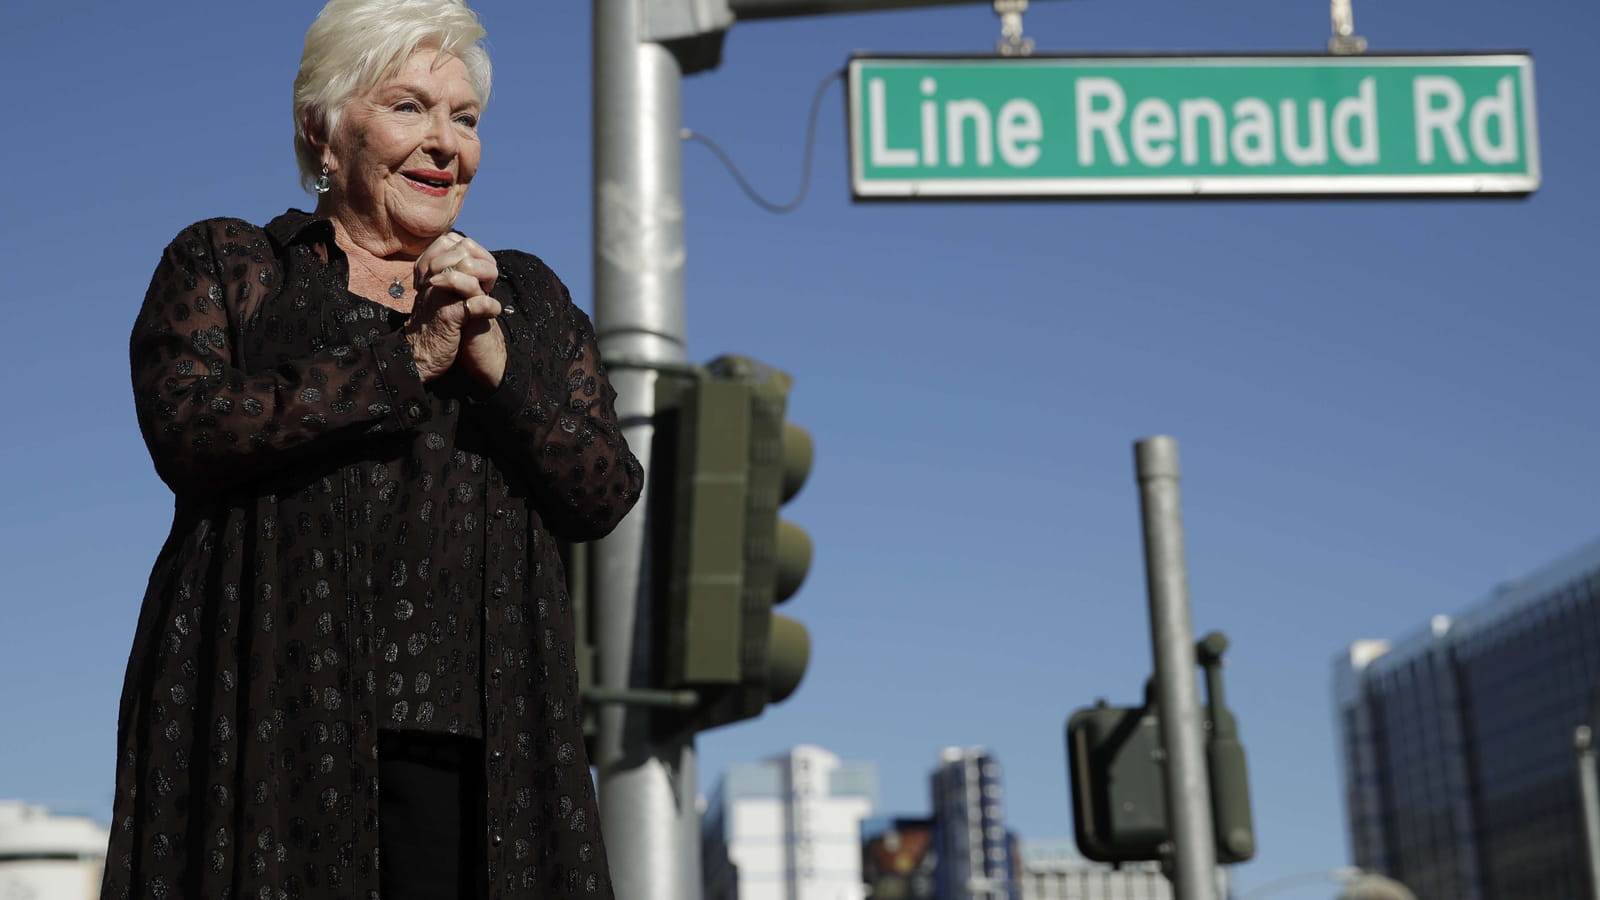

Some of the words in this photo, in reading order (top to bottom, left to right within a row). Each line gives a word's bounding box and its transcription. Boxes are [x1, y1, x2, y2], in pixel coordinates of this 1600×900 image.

[868, 75, 1044, 169] Line
[1074, 76, 1381, 168] Renaud
[1413, 75, 1520, 166] Rd
